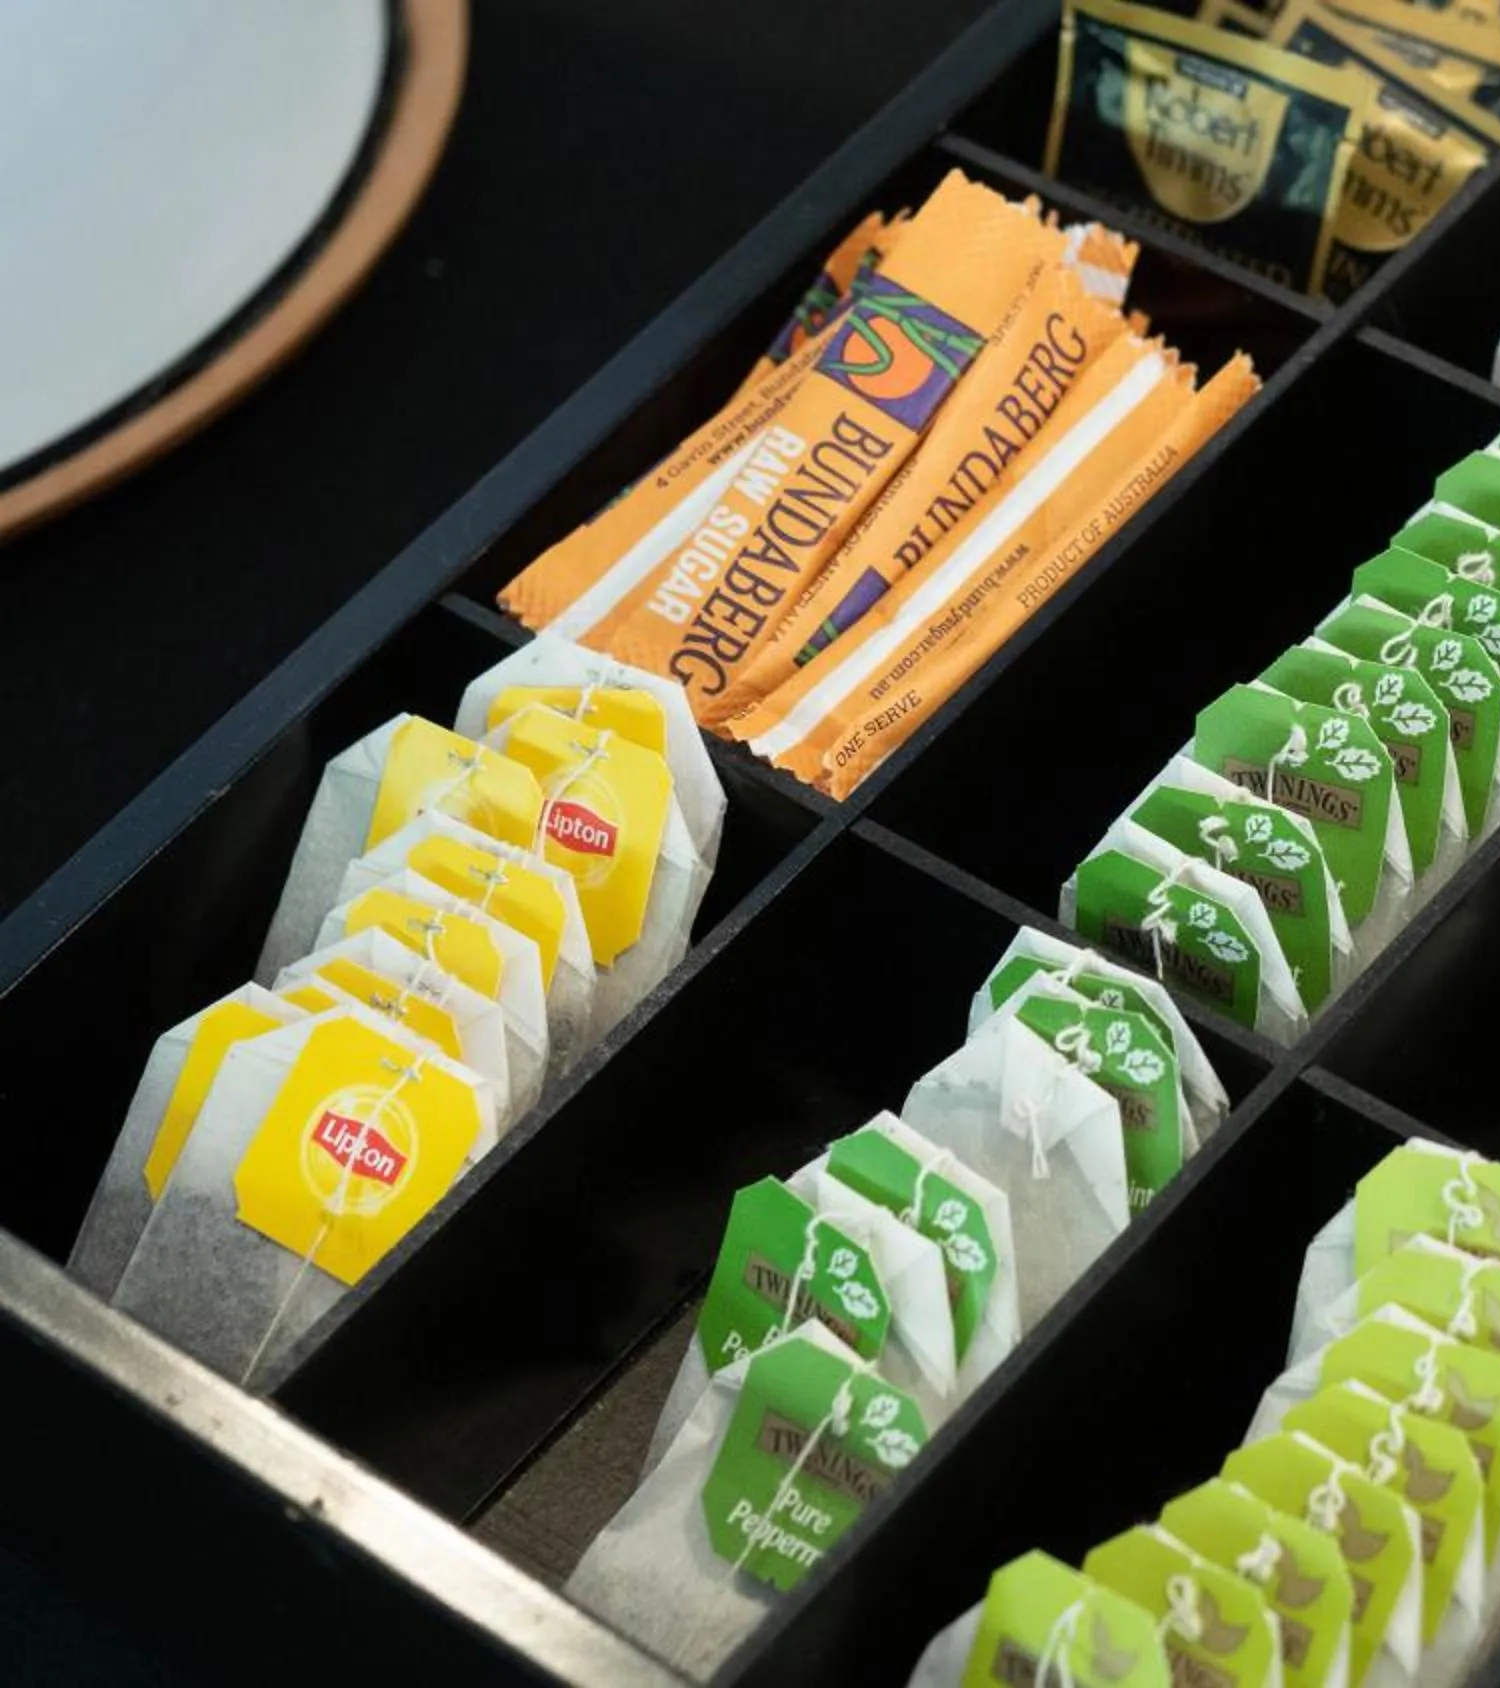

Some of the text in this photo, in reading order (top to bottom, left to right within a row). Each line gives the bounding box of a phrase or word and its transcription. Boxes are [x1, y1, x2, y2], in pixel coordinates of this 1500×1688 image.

[732, 424, 808, 507] RAW
[646, 505, 750, 625] SUGAR
[669, 411, 895, 697] BUNDABERG
[1016, 445, 1180, 609] PRODUCT OF AUSTRALIA
[835, 689, 923, 768] ONE SERVE
[545, 803, 611, 852] Lipton
[320, 1118, 396, 1178] Lipton
[726, 1498, 825, 1567] Pepperm
[775, 1487, 833, 1534] Pure
